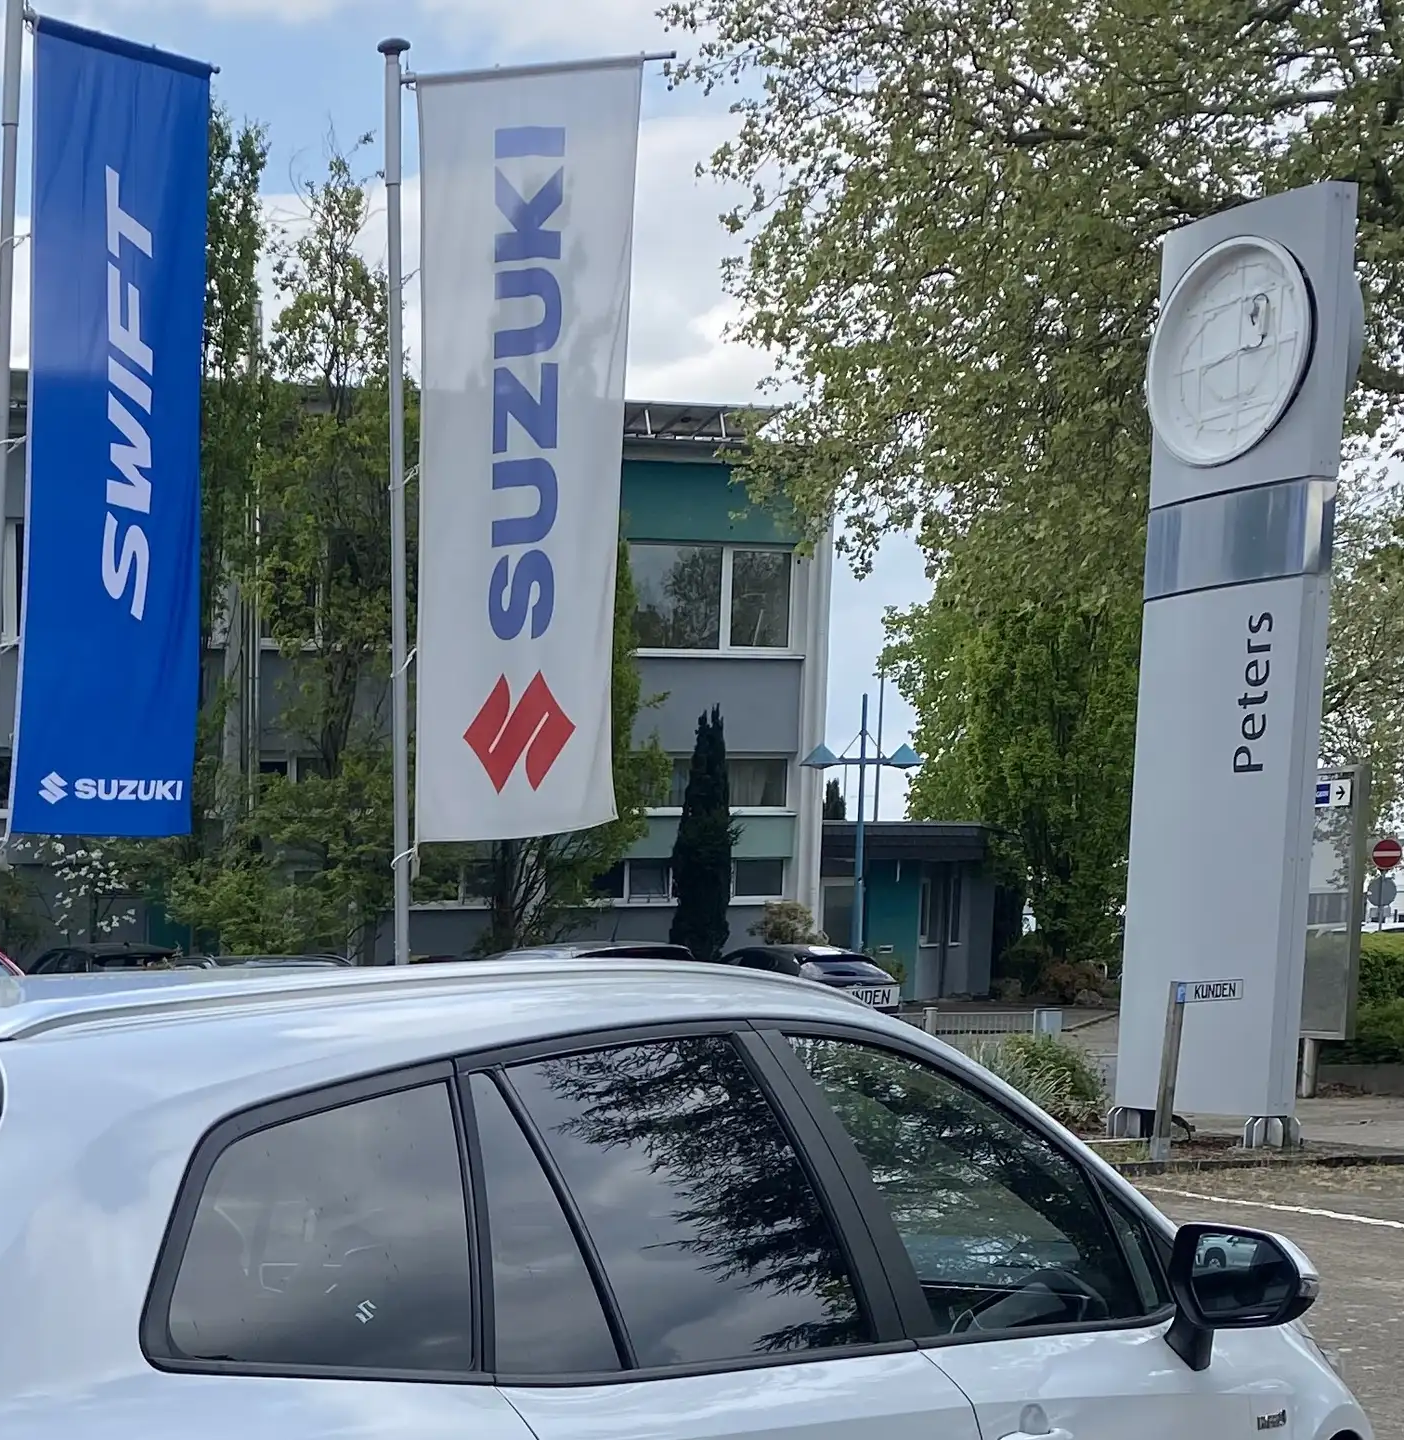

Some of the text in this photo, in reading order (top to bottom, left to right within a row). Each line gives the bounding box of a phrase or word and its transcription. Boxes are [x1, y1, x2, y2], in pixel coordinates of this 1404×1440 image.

[102, 165, 154, 620] SWIFT
[489, 126, 565, 641] SUZUKI
[1233, 610, 1274, 773] Peters
[74, 778, 183, 801] SUZUKI
[1194, 982, 1236, 1000] KUNDEN
